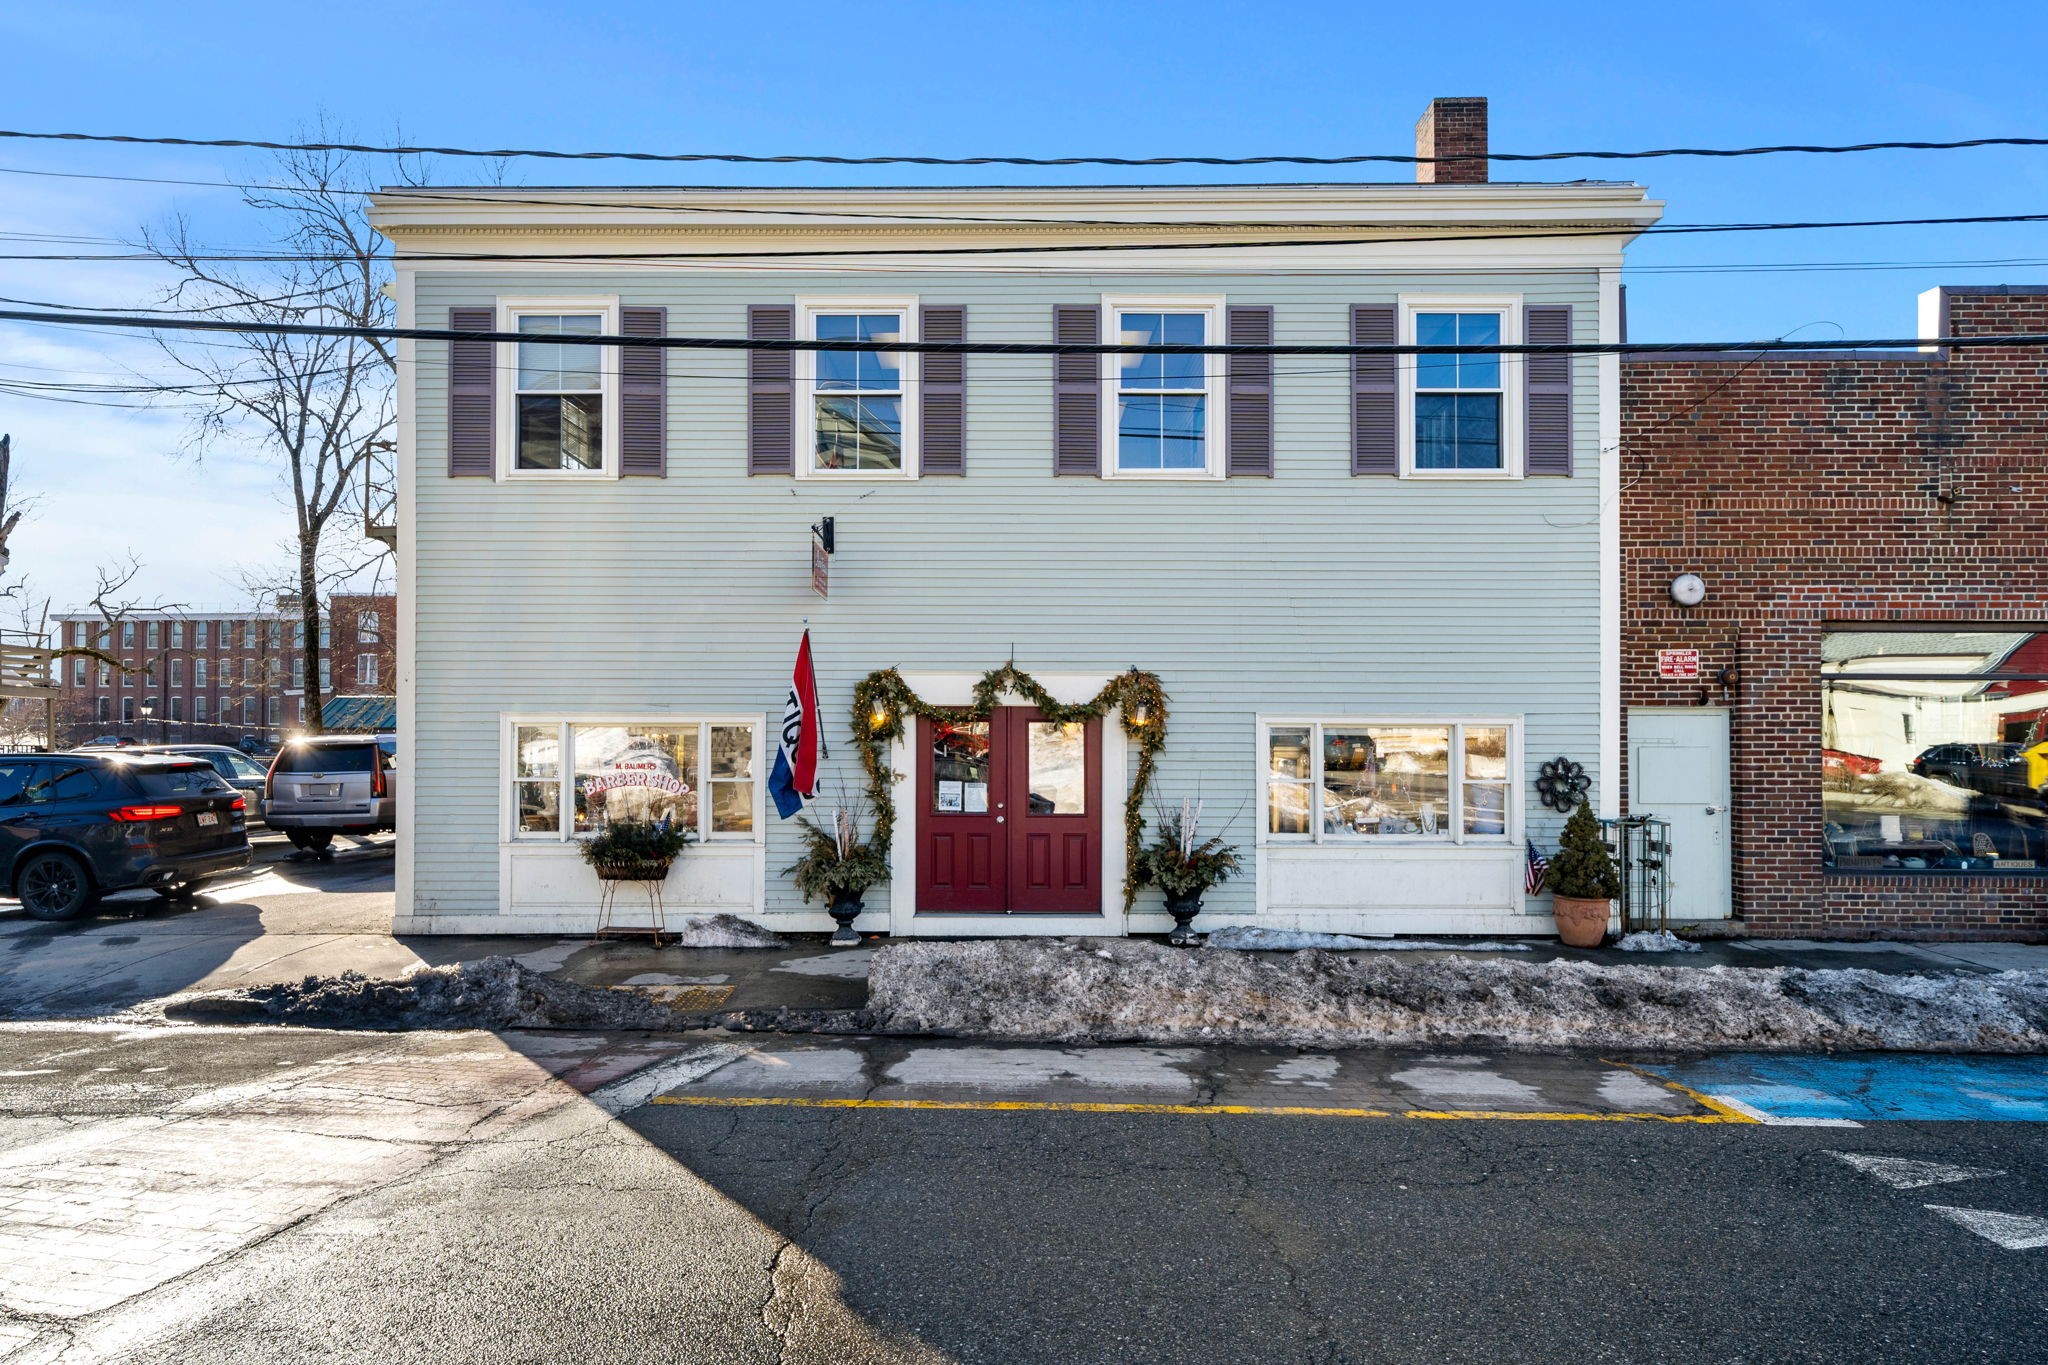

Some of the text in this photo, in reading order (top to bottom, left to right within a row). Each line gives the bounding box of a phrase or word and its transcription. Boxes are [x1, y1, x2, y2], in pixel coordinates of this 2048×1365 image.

[583, 772, 690, 797] BARBER SHOP
[1995, 860, 2033, 868] ANTIQUES
